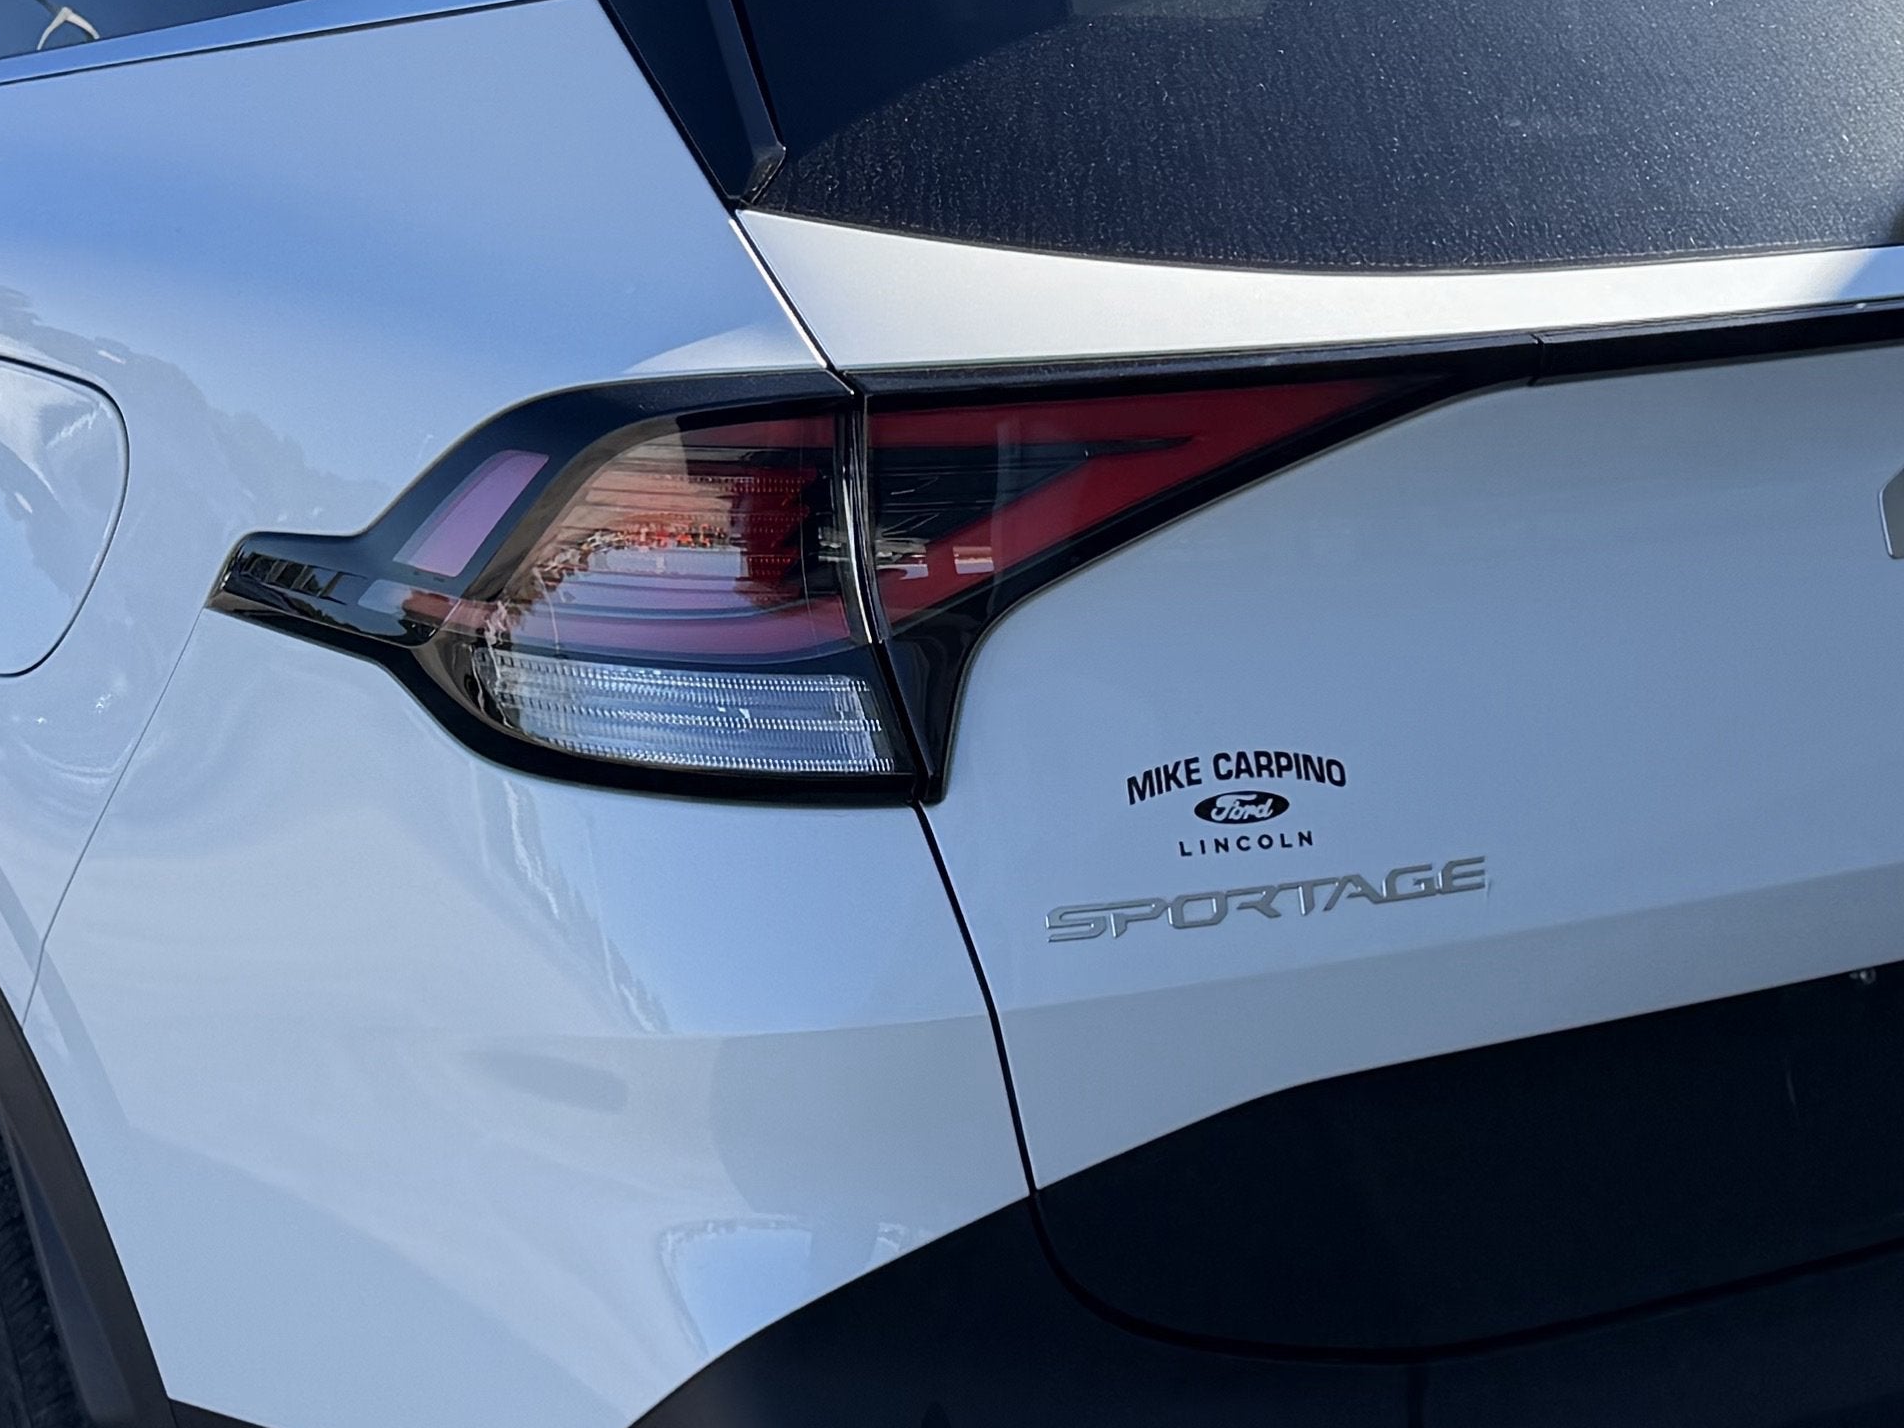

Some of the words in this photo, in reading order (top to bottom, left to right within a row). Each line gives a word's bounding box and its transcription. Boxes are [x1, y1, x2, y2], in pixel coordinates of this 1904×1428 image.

[1126, 756, 1203, 806] MIKE
[1212, 750, 1347, 788] CARPINO
[1210, 793, 1275, 822] Ford
[1178, 830, 1314, 857] LINCOLN
[1044, 855, 1487, 944] SPORTAGE
